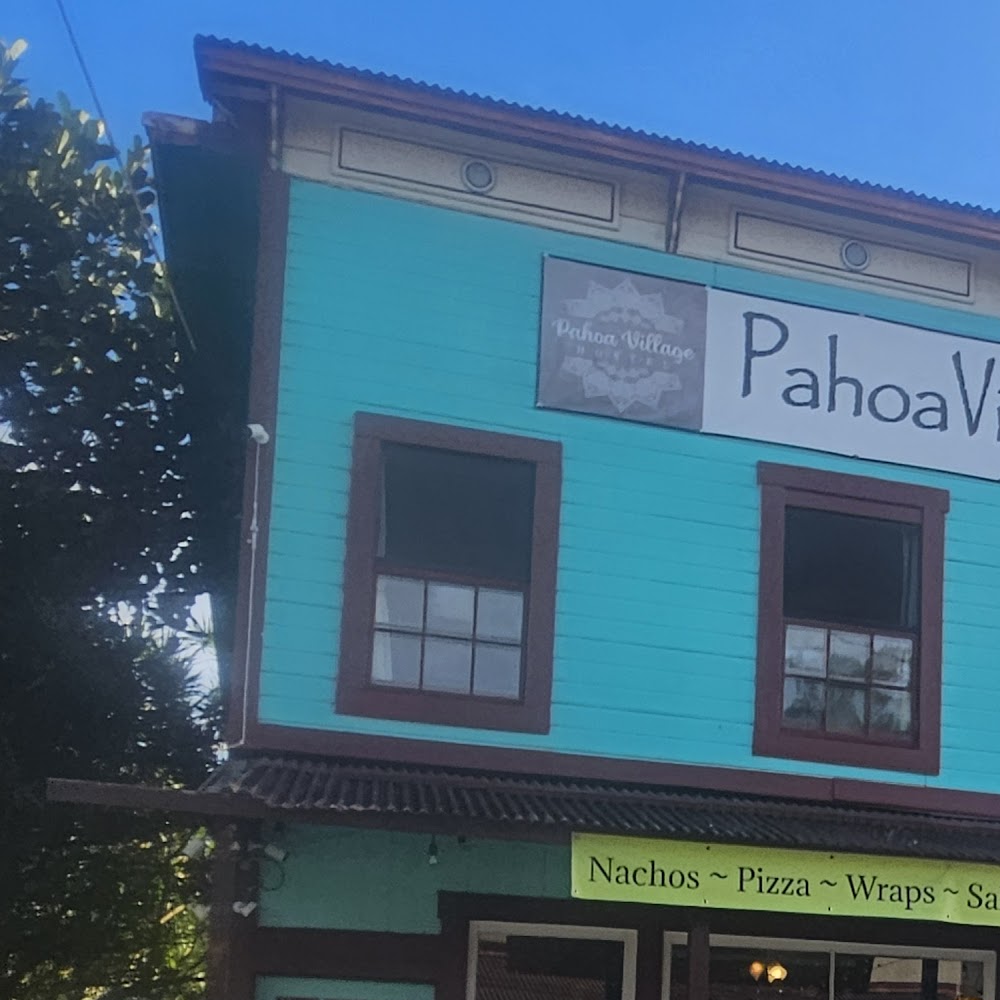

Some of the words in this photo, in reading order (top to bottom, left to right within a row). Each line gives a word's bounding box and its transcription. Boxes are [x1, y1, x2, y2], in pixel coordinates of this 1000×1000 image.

[551, 317, 618, 347] Pahoa
[620, 329, 695, 364] Village
[588, 855, 700, 889] Nachos
[737, 866, 811, 897] Pizza
[845, 873, 935, 910] Wraps
